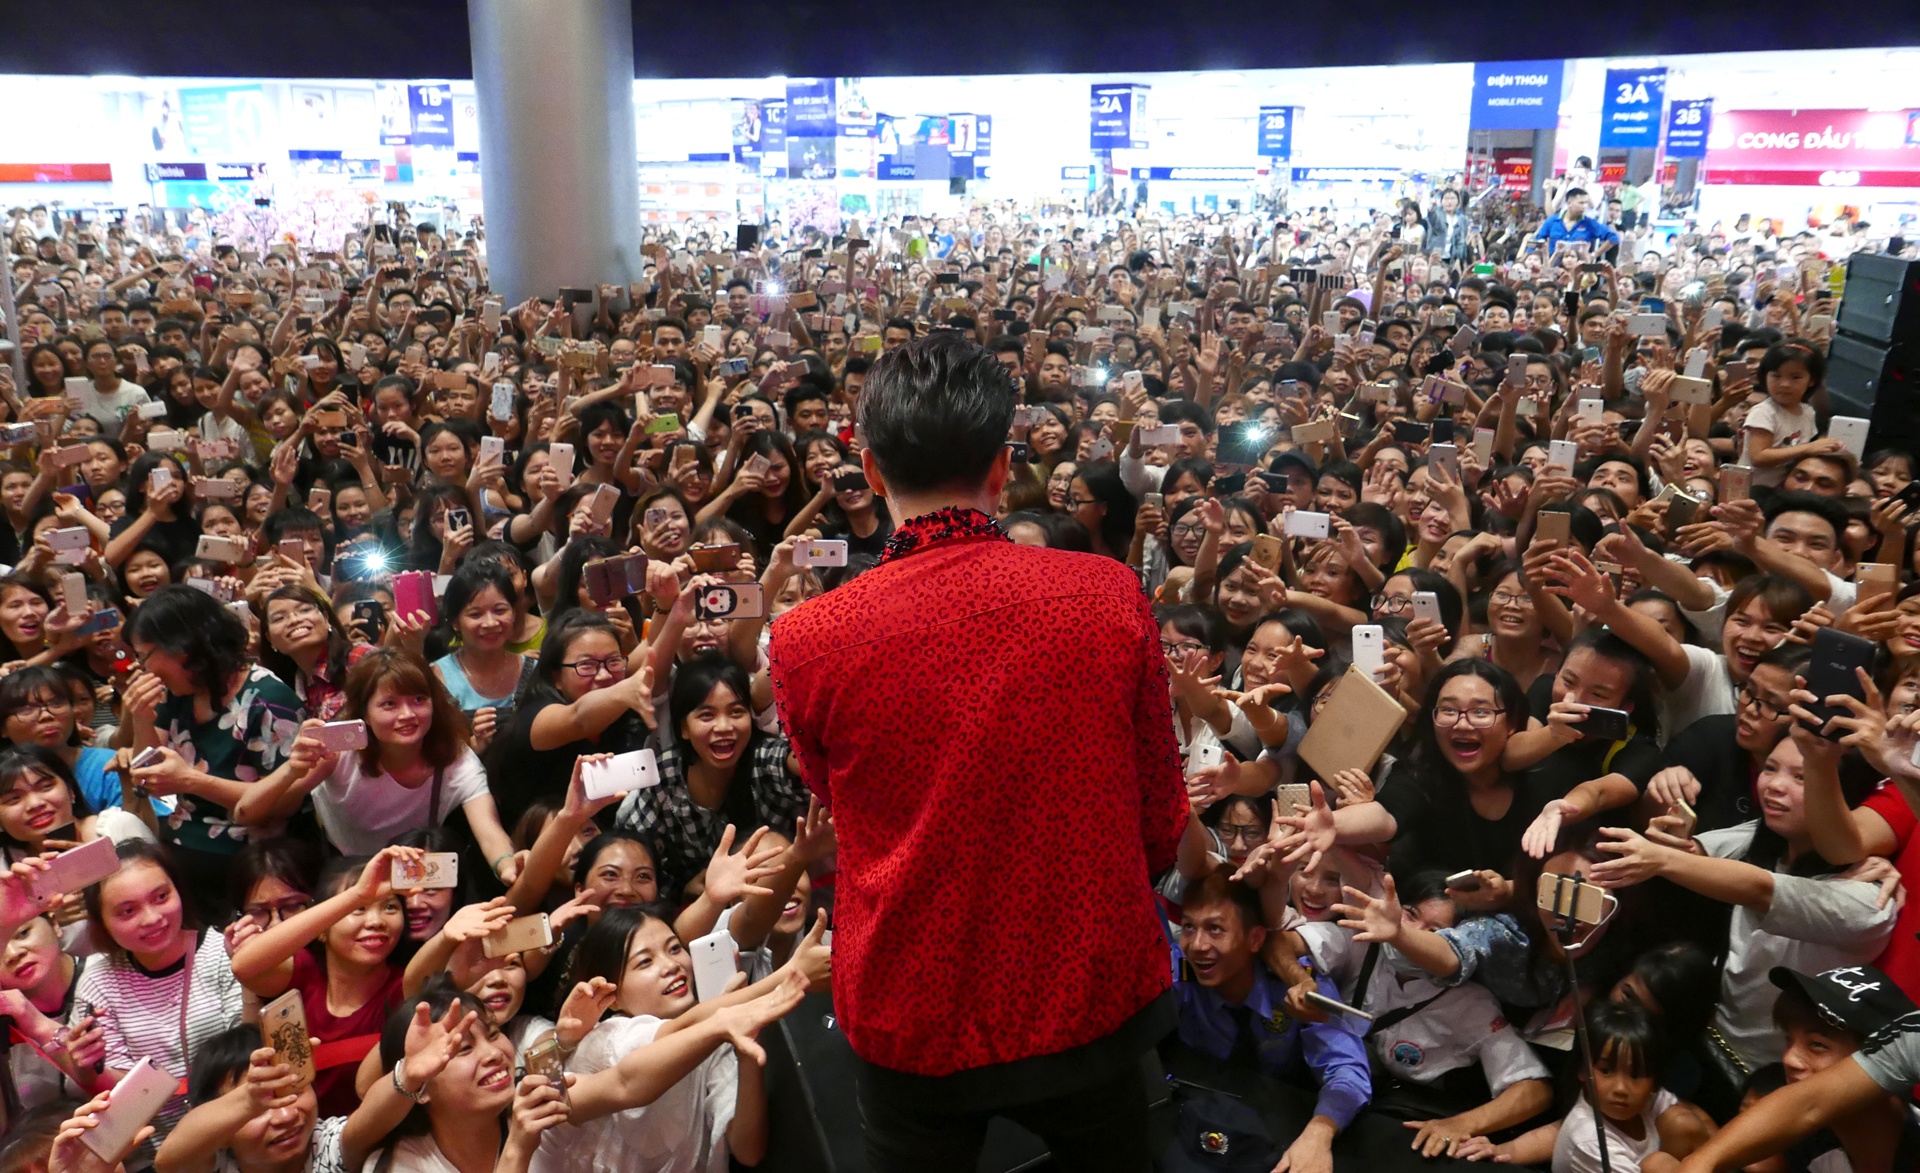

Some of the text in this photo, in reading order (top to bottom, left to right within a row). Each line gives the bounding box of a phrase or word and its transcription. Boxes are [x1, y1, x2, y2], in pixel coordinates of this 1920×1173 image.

[1487, 74, 1548, 88] ĐIỆN THOẠI
[1616, 83, 1649, 104] 3A
[1099, 96, 1123, 113] 2A
[1488, 97, 1543, 106] MOBILE PHONE
[766, 108, 780, 122] 1C
[1266, 115, 1285, 129] 2B
[1675, 108, 1701, 124] 3B
[1737, 132, 1799, 149] CONG
